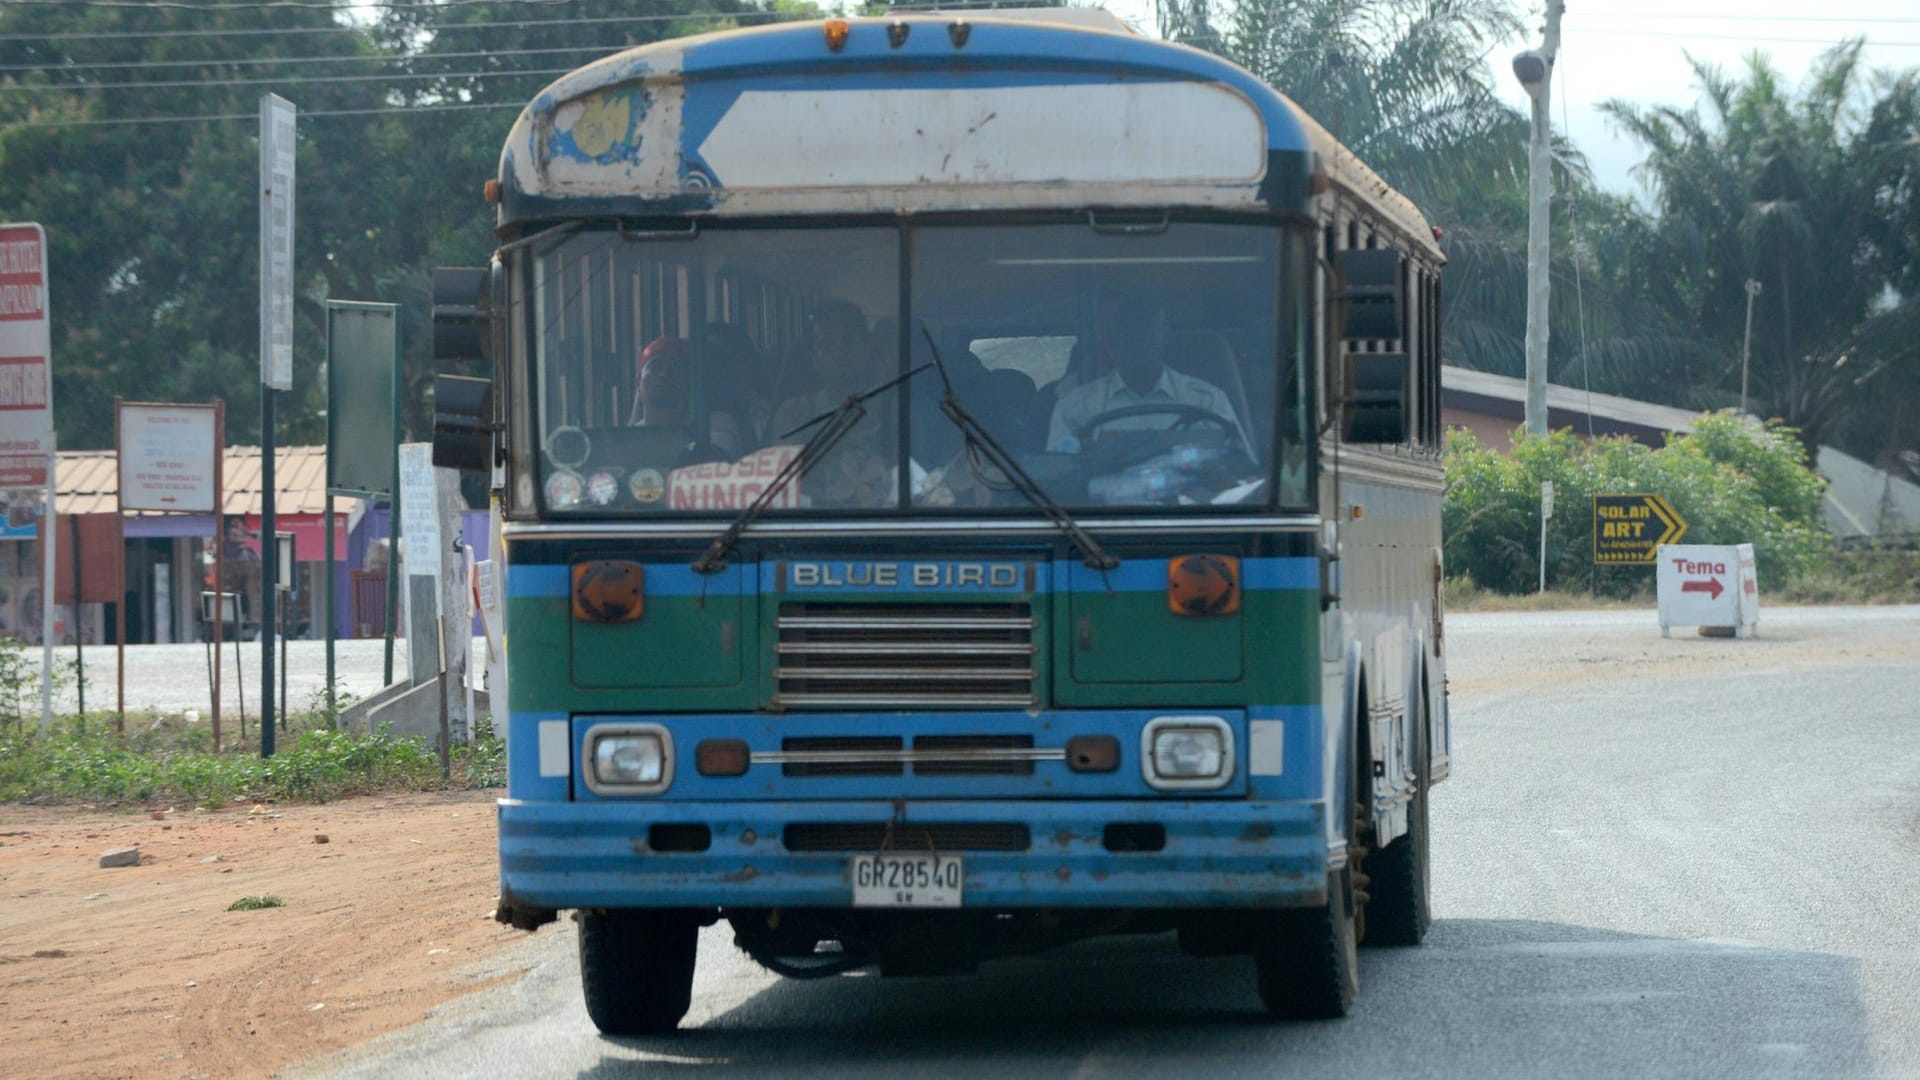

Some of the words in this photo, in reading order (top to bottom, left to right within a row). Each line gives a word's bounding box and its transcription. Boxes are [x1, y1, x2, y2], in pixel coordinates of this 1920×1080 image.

[1598, 506, 1650, 519] SOLAR
[1603, 522, 1646, 538] ART
[793, 563, 898, 586] BLUE
[912, 563, 1017, 586] BIRD
[1671, 558, 1726, 575] Tema
